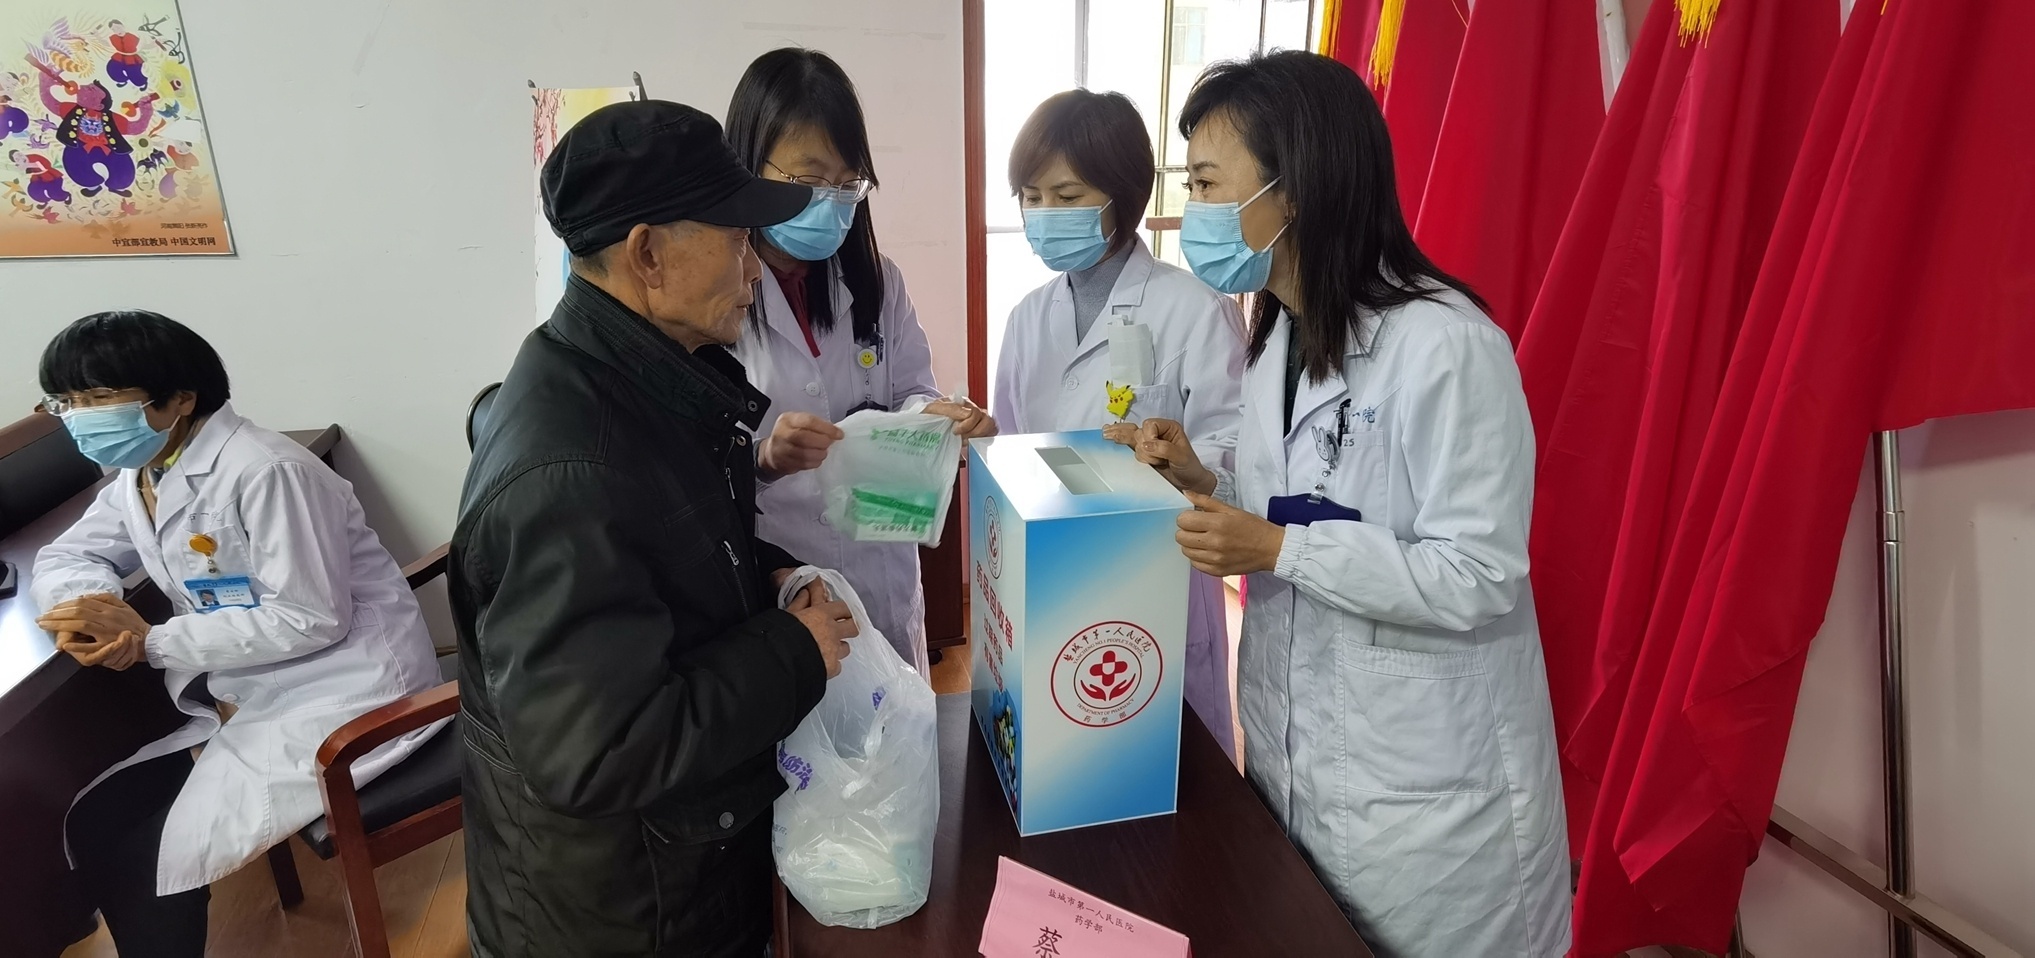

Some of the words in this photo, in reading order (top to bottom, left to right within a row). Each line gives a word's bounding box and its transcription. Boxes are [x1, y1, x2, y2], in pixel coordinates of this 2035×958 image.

[112, 237, 168, 247] 中宣部宣教局
[170, 236, 216, 246] 中国文明网
[976, 559, 1013, 653] 药品回收箱
[1073, 642, 1095, 664] YANCHENG
[1128, 641, 1145, 659] HOSPITAL
[1077, 702, 1103, 716] DEPARTMENT
[1111, 698, 1134, 715] PHARMACY
[1048, 888, 1134, 933] 盐城市第一人民医院
[1074, 914, 1103, 935] 药学部
[1032, 926, 1062, 958] 蔡
